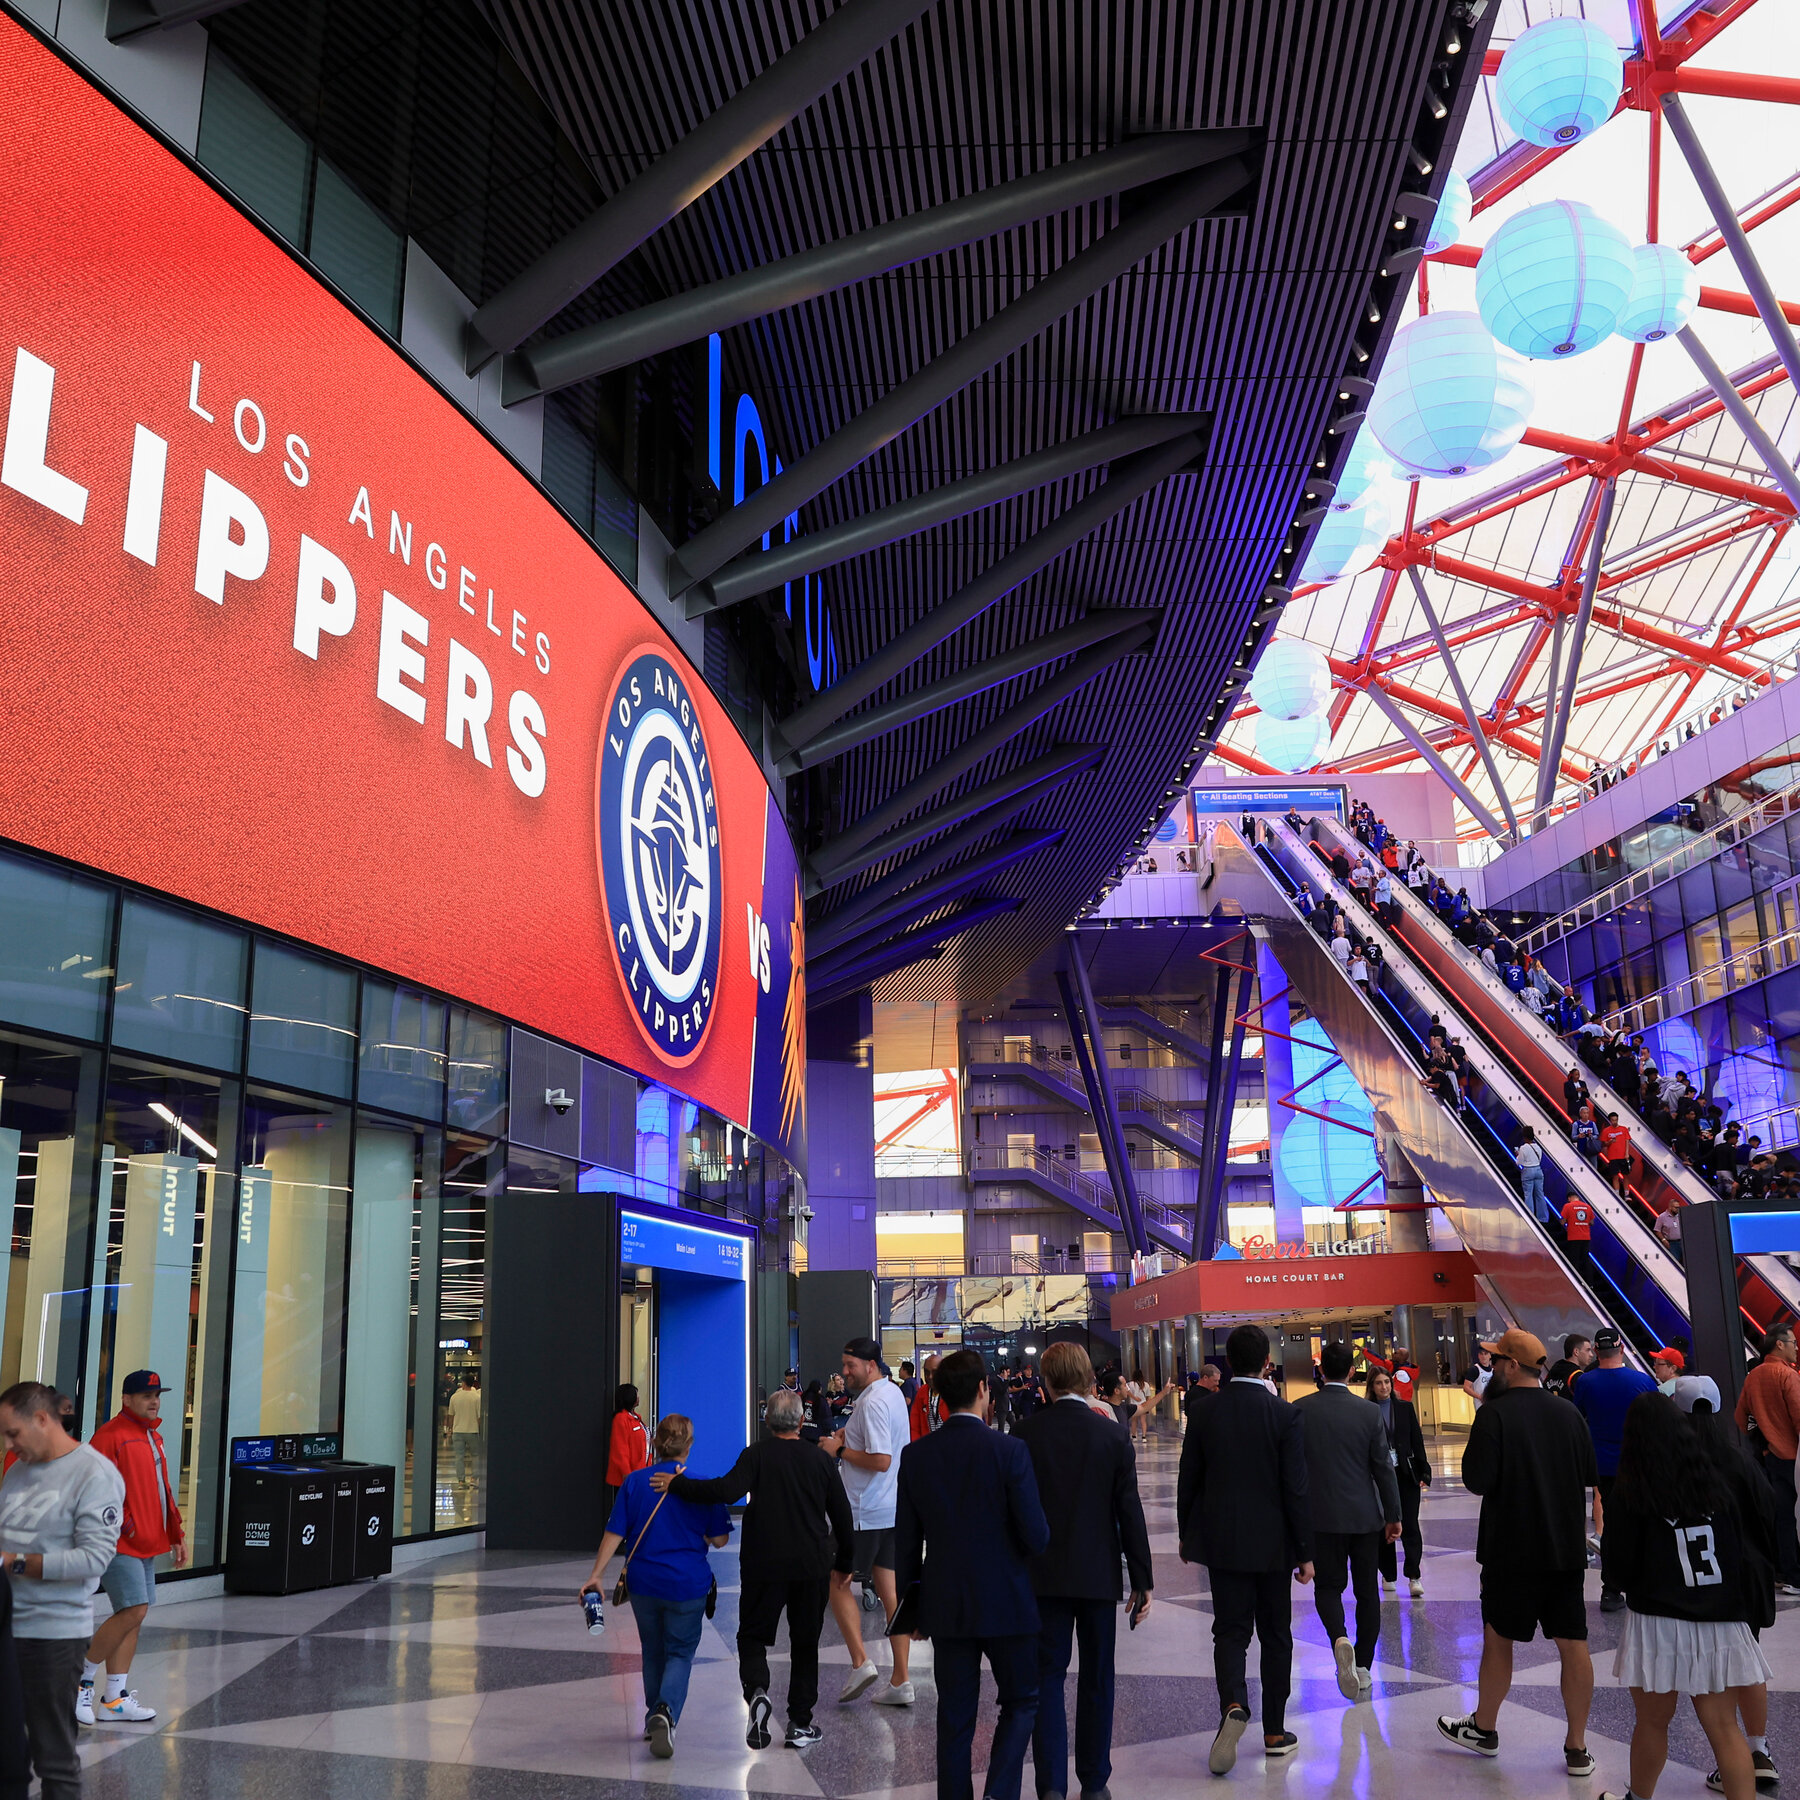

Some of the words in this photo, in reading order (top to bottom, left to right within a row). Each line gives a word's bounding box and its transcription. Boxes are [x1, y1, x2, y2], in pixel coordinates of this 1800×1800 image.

[188, 359, 311, 488] LOS
[348, 485, 552, 676] ANGELES
[1, 347, 549, 799] LIPPERS
[609, 676, 642, 758] LOS
[654, 667, 719, 848] ANGELES
[1222, 792, 1252, 801] Seating
[1253, 792, 1288, 800] Sections
[746, 902, 771, 994] VS
[618, 922, 711, 1043] CLIPPERS
[1512, 972, 1519, 981] 2
[163, 1167, 178, 1237] INTUIT
[241, 1179, 254, 1245] INTUIT
[623, 1222, 638, 1238] 2-17
[1241, 1234, 1310, 1260] Coors
[1313, 1239, 1374, 1257] LIGHT
[1246, 1275, 1278, 1283] HOME
[1282, 1273, 1319, 1282] COURT
[1323, 1273, 1345, 1281] BAR
[299, 1492, 323, 1501] RECYCLING
[365, 1486, 386, 1495] ORGANICS
[245, 1522, 271, 1530] INTUIT
[1674, 1524, 1723, 1588] 13
